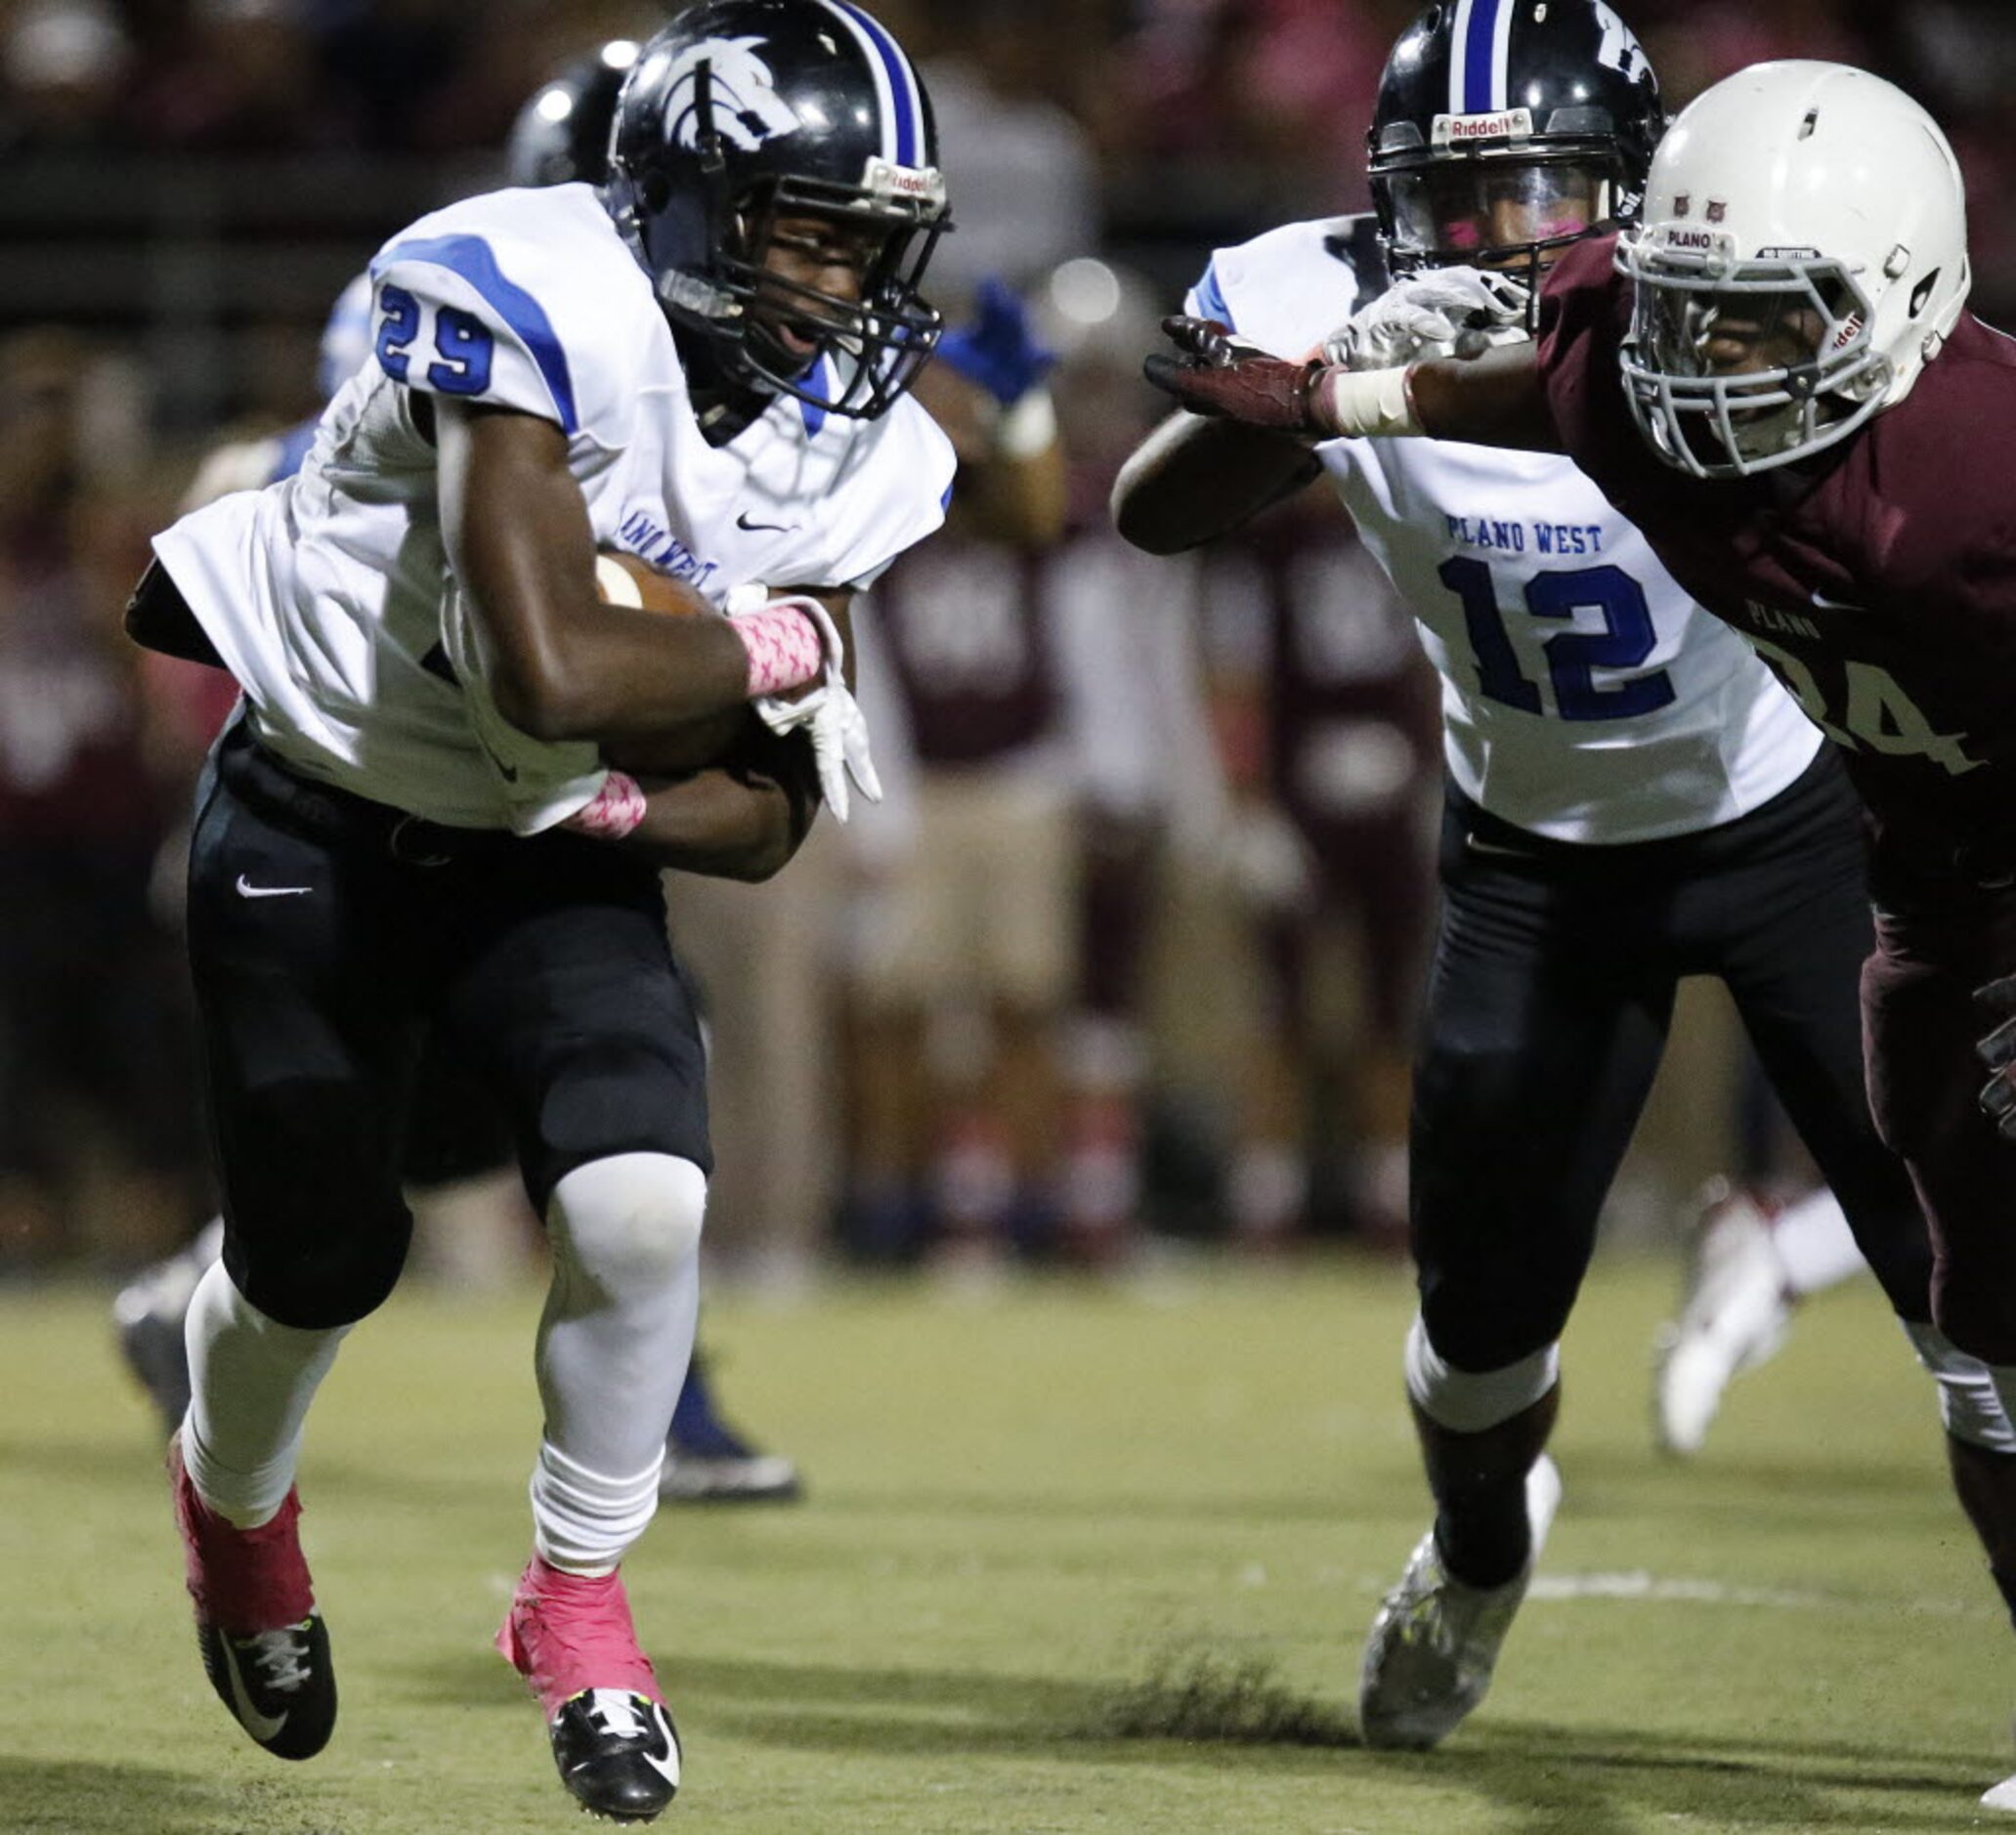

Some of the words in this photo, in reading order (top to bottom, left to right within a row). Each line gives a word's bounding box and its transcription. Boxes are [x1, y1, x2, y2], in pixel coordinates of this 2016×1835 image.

[1452, 117, 1511, 137] Riddell
[1667, 230, 1711, 249] PLANO
[375, 282, 494, 398] 29
[1831, 314, 1866, 351] dell
[1446, 514, 1524, 552] PLANO
[1533, 523, 1602, 554] WEST
[1437, 555, 1677, 721] 12
